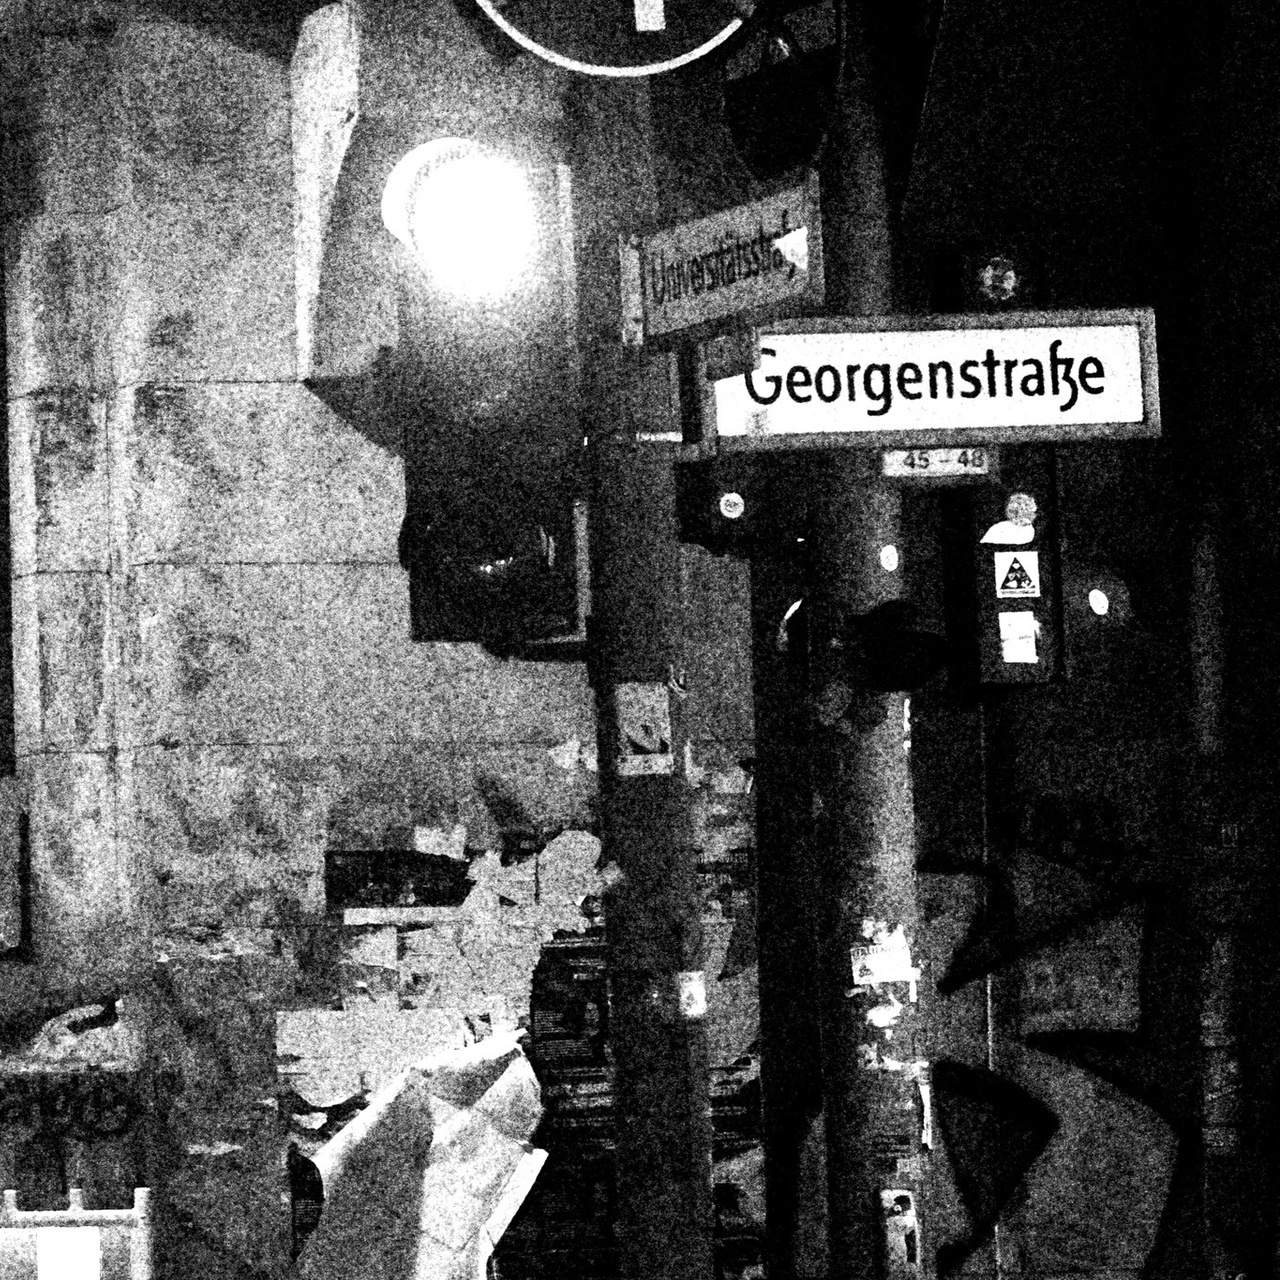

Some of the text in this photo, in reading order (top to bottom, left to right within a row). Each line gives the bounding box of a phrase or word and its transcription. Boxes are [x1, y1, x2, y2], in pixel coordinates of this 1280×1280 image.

[651, 208, 798, 305] Universitätsstra
[744, 339, 1105, 416] Georgenstraße
[903, 450, 930, 469] 45
